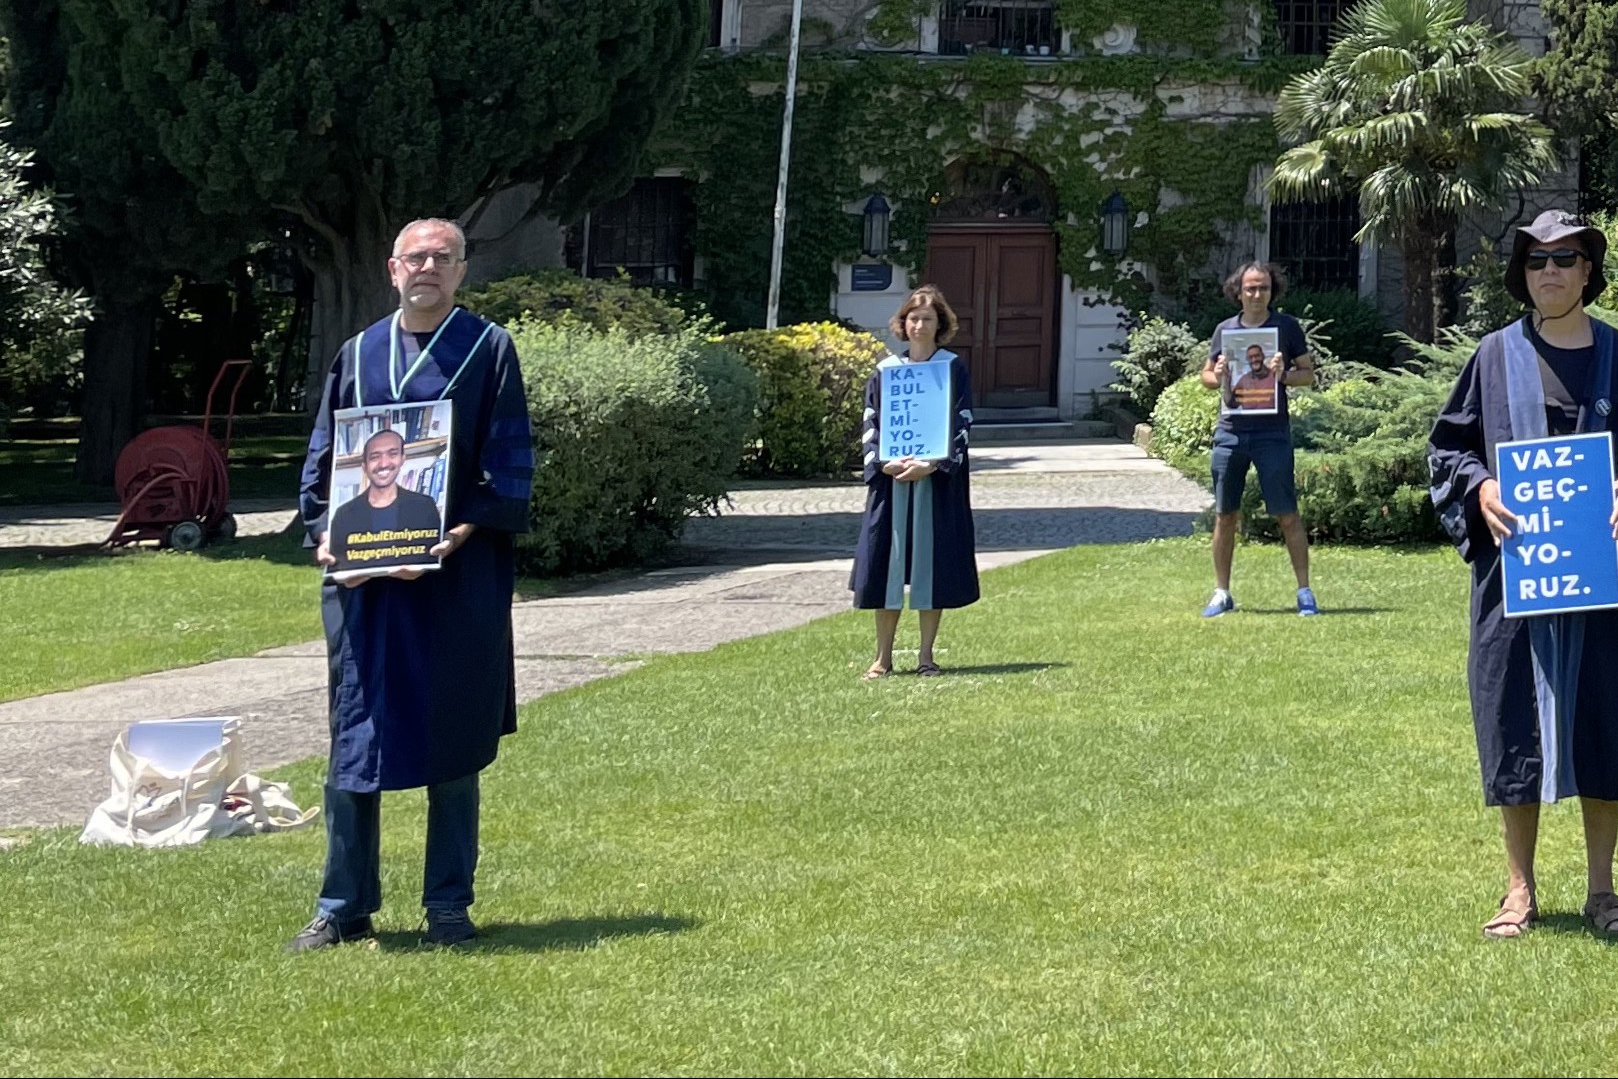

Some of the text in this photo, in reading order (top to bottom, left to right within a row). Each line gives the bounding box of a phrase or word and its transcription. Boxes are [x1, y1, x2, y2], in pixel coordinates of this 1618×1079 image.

[890, 368, 923, 381] KA-
[890, 383, 925, 396] BUL
[890, 399, 918, 411] ET-
[890, 411, 918, 427] Mİ-
[890, 429, 922, 441] YO-
[890, 444, 930, 457] RUZ.
[1512, 446, 1584, 471] VAZ-
[1514, 477, 1588, 502] GEÇ-
[1517, 506, 1564, 535] Mİ-
[347, 528, 438, 544] #KabulEtmiyoruz
[346, 545, 426, 561] Vazgeçmiyoruz
[1517, 543, 1572, 566] YO-
[1519, 575, 1591, 600] RUZ.
